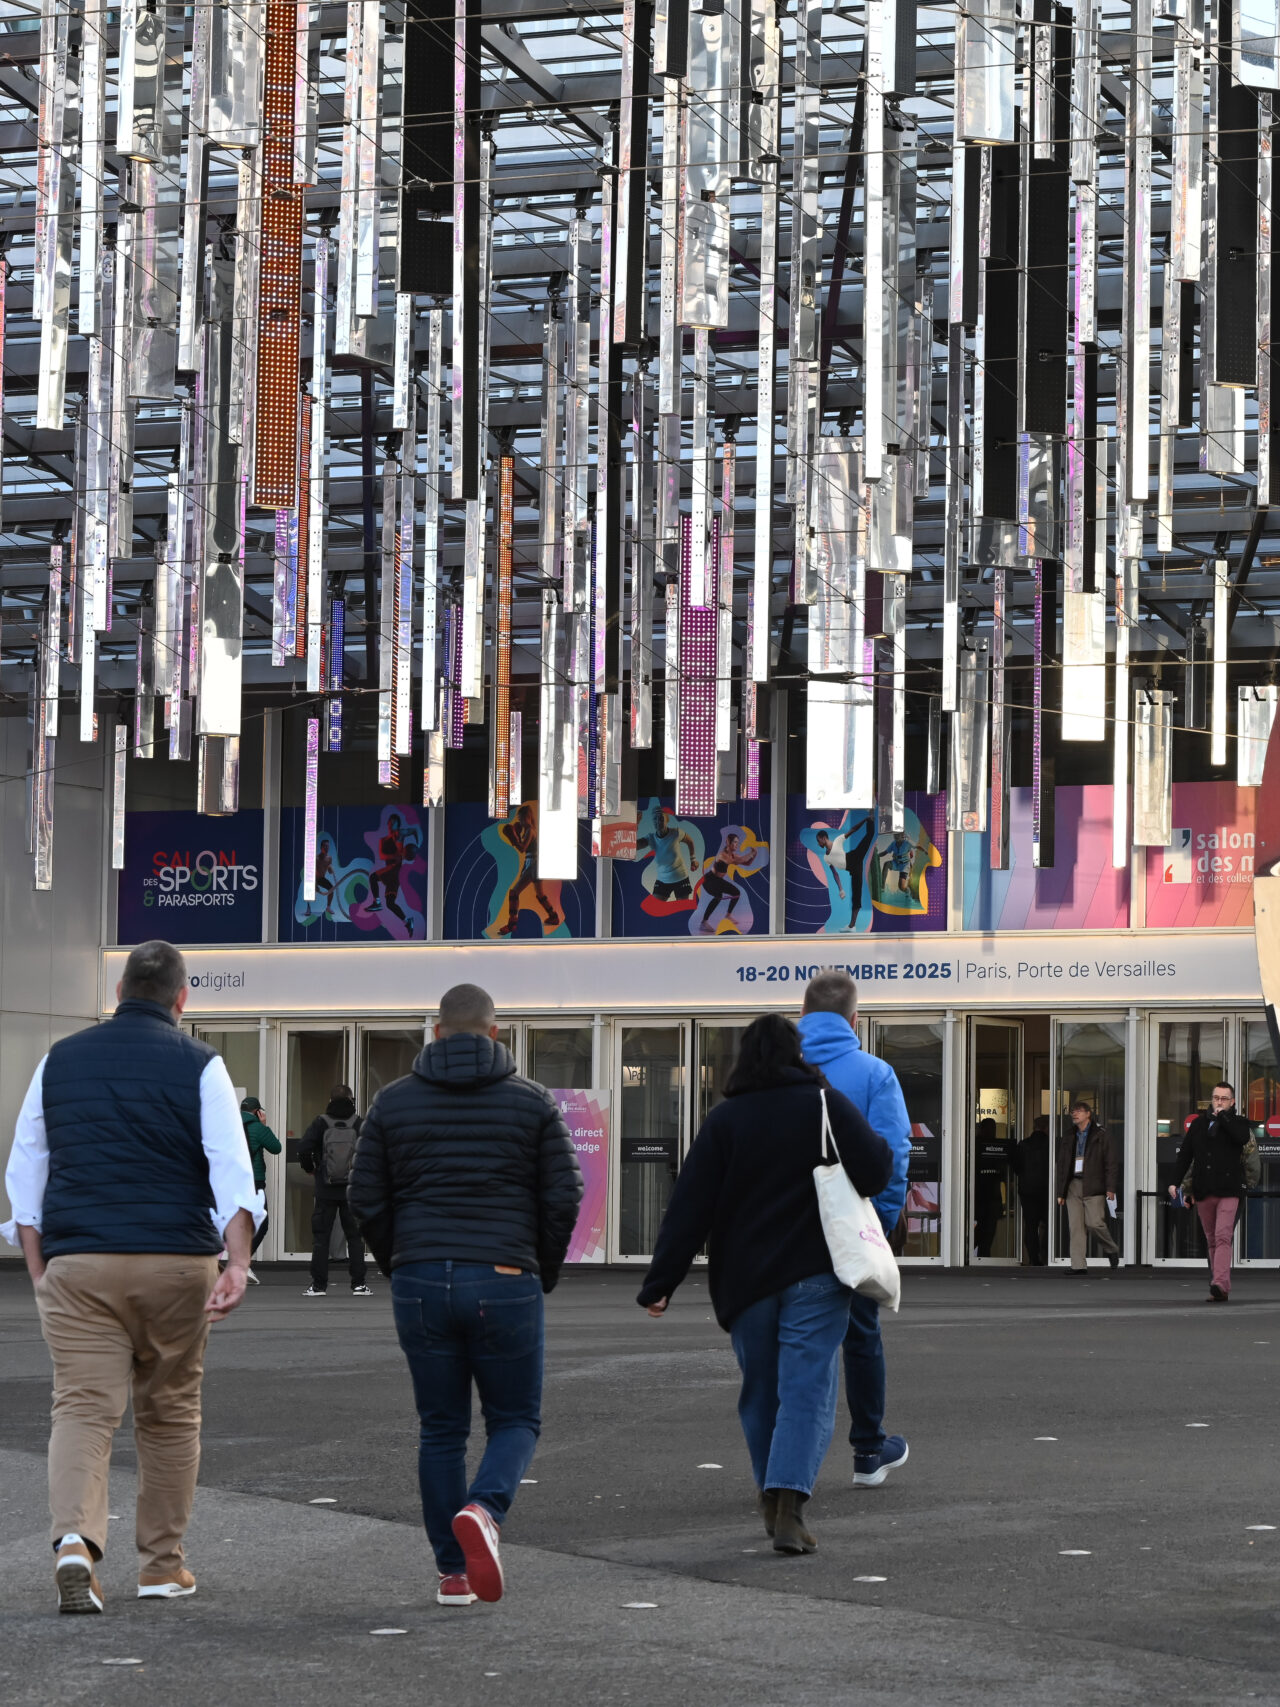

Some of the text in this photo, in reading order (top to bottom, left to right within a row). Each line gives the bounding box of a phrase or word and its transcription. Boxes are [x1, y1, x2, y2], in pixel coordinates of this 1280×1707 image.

[1196, 827, 1255, 849] salon
[152, 850, 236, 876] SALON
[1197, 851, 1233, 872] des
[159, 865, 258, 892] SPORTS
[1196, 874, 1205, 883] et
[1208, 873, 1223, 883] des
[143, 890, 235, 907] & PARASPORTS
[736, 966, 790, 982] 18-20
[903, 963, 951, 979] 2025
[966, 961, 1176, 979] Paris, Porte de Versailles
[188, 971, 244, 991] odigital
[574, 1127, 603, 1137] direct
